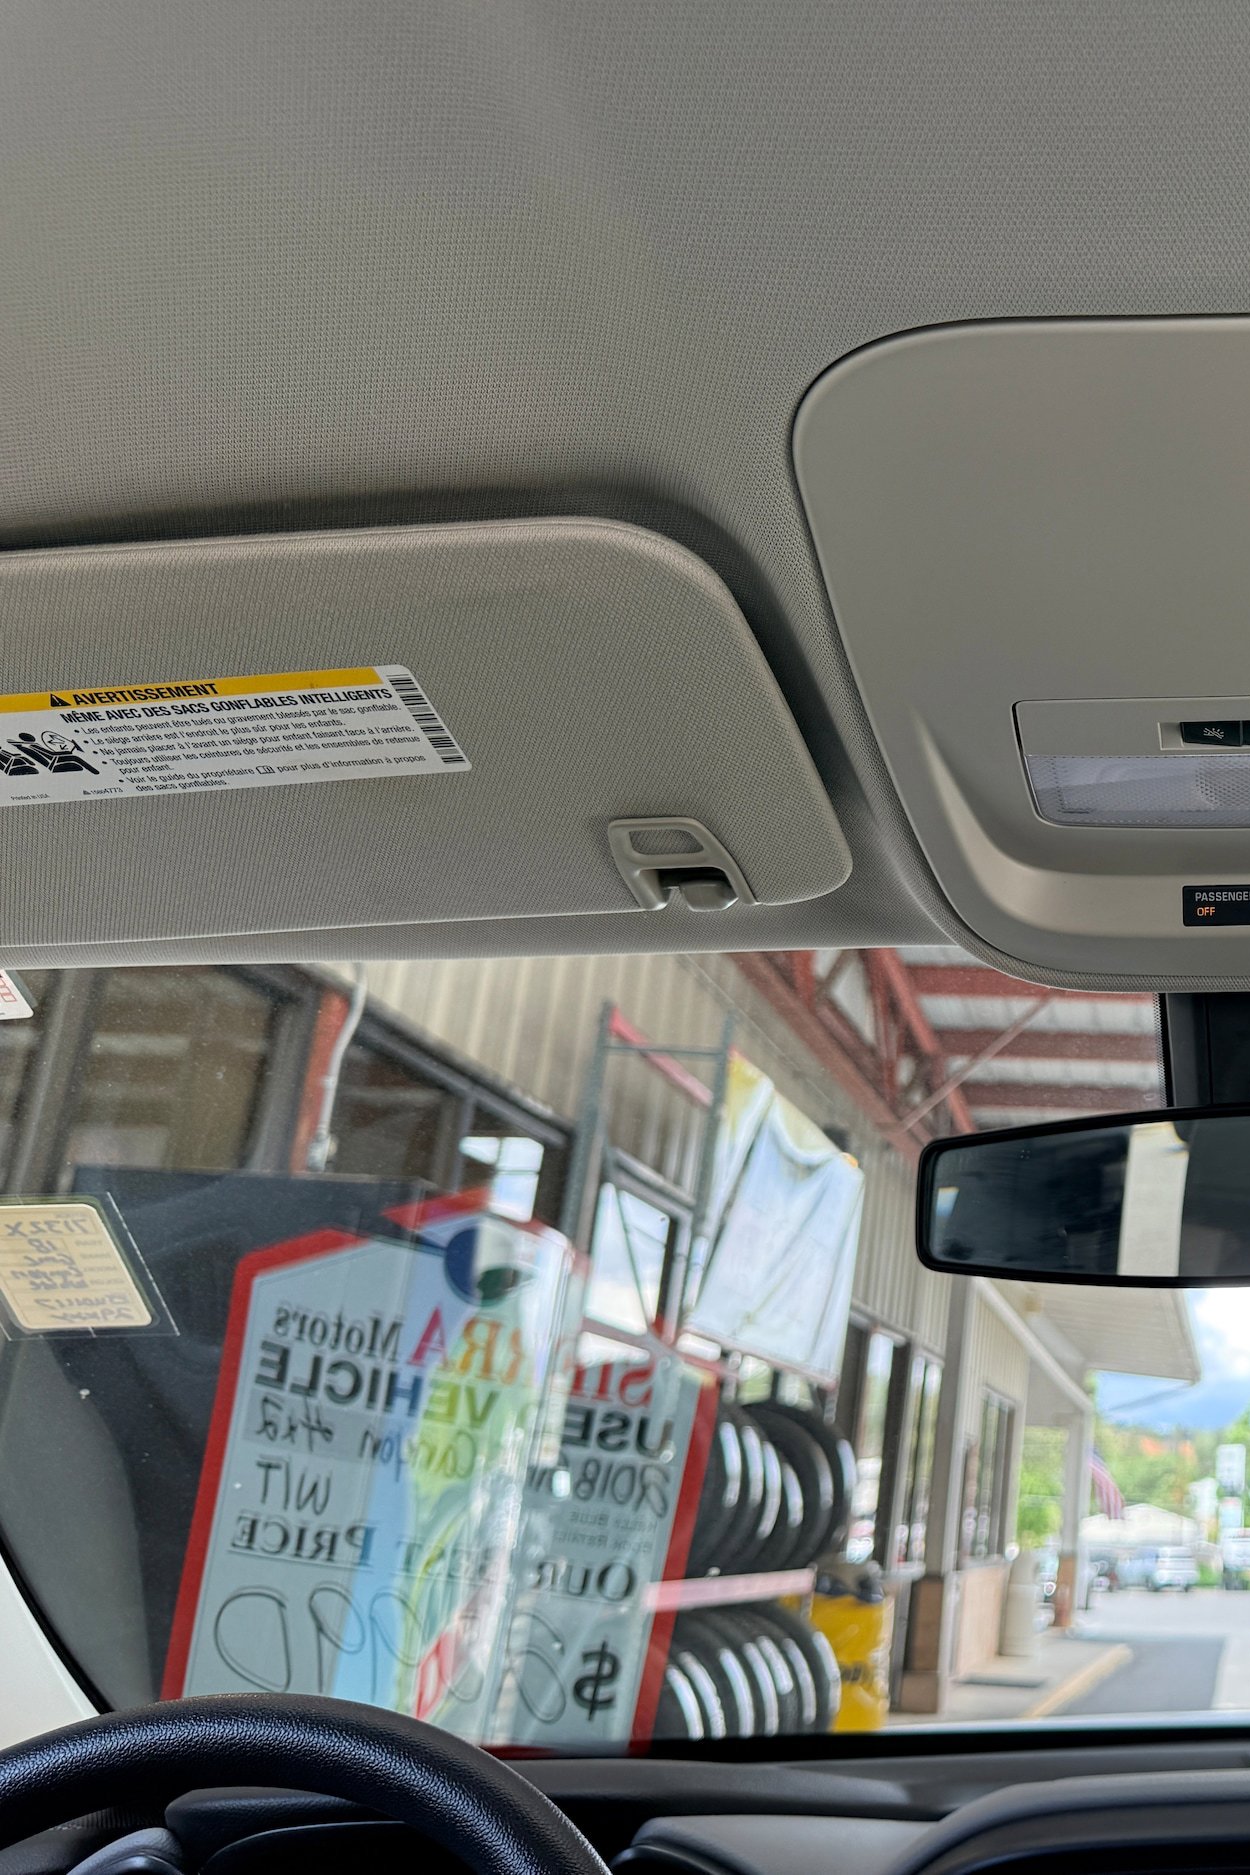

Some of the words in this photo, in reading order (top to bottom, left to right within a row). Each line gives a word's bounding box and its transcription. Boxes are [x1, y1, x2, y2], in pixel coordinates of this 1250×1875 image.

[60, 711, 106, 723] MÊME
[107, 708, 141, 720] AVEC
[143, 706, 170, 717] DES
[172, 702, 210, 715] SACS
[210, 694, 299, 712] GONFLABLES
[299, 688, 393, 704] INTELLIGENTS
[72, 683, 219, 705] AVERTISSEMENT
[81, 726, 99, 734] Les
[100, 722, 134, 733] enfants
[135, 720, 171, 732] peuvent
[172, 718, 191, 728] être
[193, 716, 212, 725] tués
[214, 716, 225, 724] ou
[227, 711, 277, 726] gravement
[277, 709, 310, 720] blessés
[312, 707, 327, 717] par
[329, 706, 338, 714] le
[339, 706, 356, 714] sac
[357, 702, 401, 714] gonflable.
[91, 736, 105, 745] Le
[106, 733, 132, 745] siège
[133, 731, 163, 742] arrière
[164, 730, 179, 739] est
[181, 726, 219, 738] l'endroit
[220, 725, 229, 733] le
[230, 724, 251, 734] plus
[253, 724, 267, 732] sûr
[269, 721, 293, 732] pour
[294, 719, 307, 729] les
[308, 717, 345, 728] enfants.
[100, 747, 116, 756] Ne
[117, 744, 146, 756] jamais
[148, 742, 176, 753] placer
[187, 738, 217, 749] l'avant
[219, 739, 230, 747] un
[232, 736, 257, 748] siège
[261, 733, 281, 744] pour
[283, 730, 312, 741] enfant
[313, 727, 344, 738] faisant
[346, 726, 366, 736] face
[376, 724, 414, 734] l'arrière.
[111, 755, 152, 767] Toujours
[153, 753, 184, 764] utiliser
[185, 751, 198, 760] les
[200, 747, 242, 760] ceintures
[244, 747, 255, 755] de
[257, 743, 293, 755] sécurité
[295, 743, 304, 752] et
[305, 742, 319, 751] les
[321, 736, 370, 749] ensembles
[372, 736, 383, 745] de
[386, 734, 420, 744] retenue
[119, 765, 140, 775] pour
[142, 762, 174, 772] enfant.
[126, 775, 148, 784] Voir
[149, 774, 157, 783] le
[159, 773, 185, 783] guide
[187, 771, 199, 780] du
[200, 766, 255, 780] propriétaire
[277, 764, 299, 773] pour
[300, 762, 322, 773] plus
[324, 756, 383, 769] d'information
[394, 754, 426, 765] propos
[136, 783, 153, 792] des
[155, 781, 177, 791] sacs
[179, 778, 229, 791] gonflables.
[1197, 907, 1215, 916] OFF
